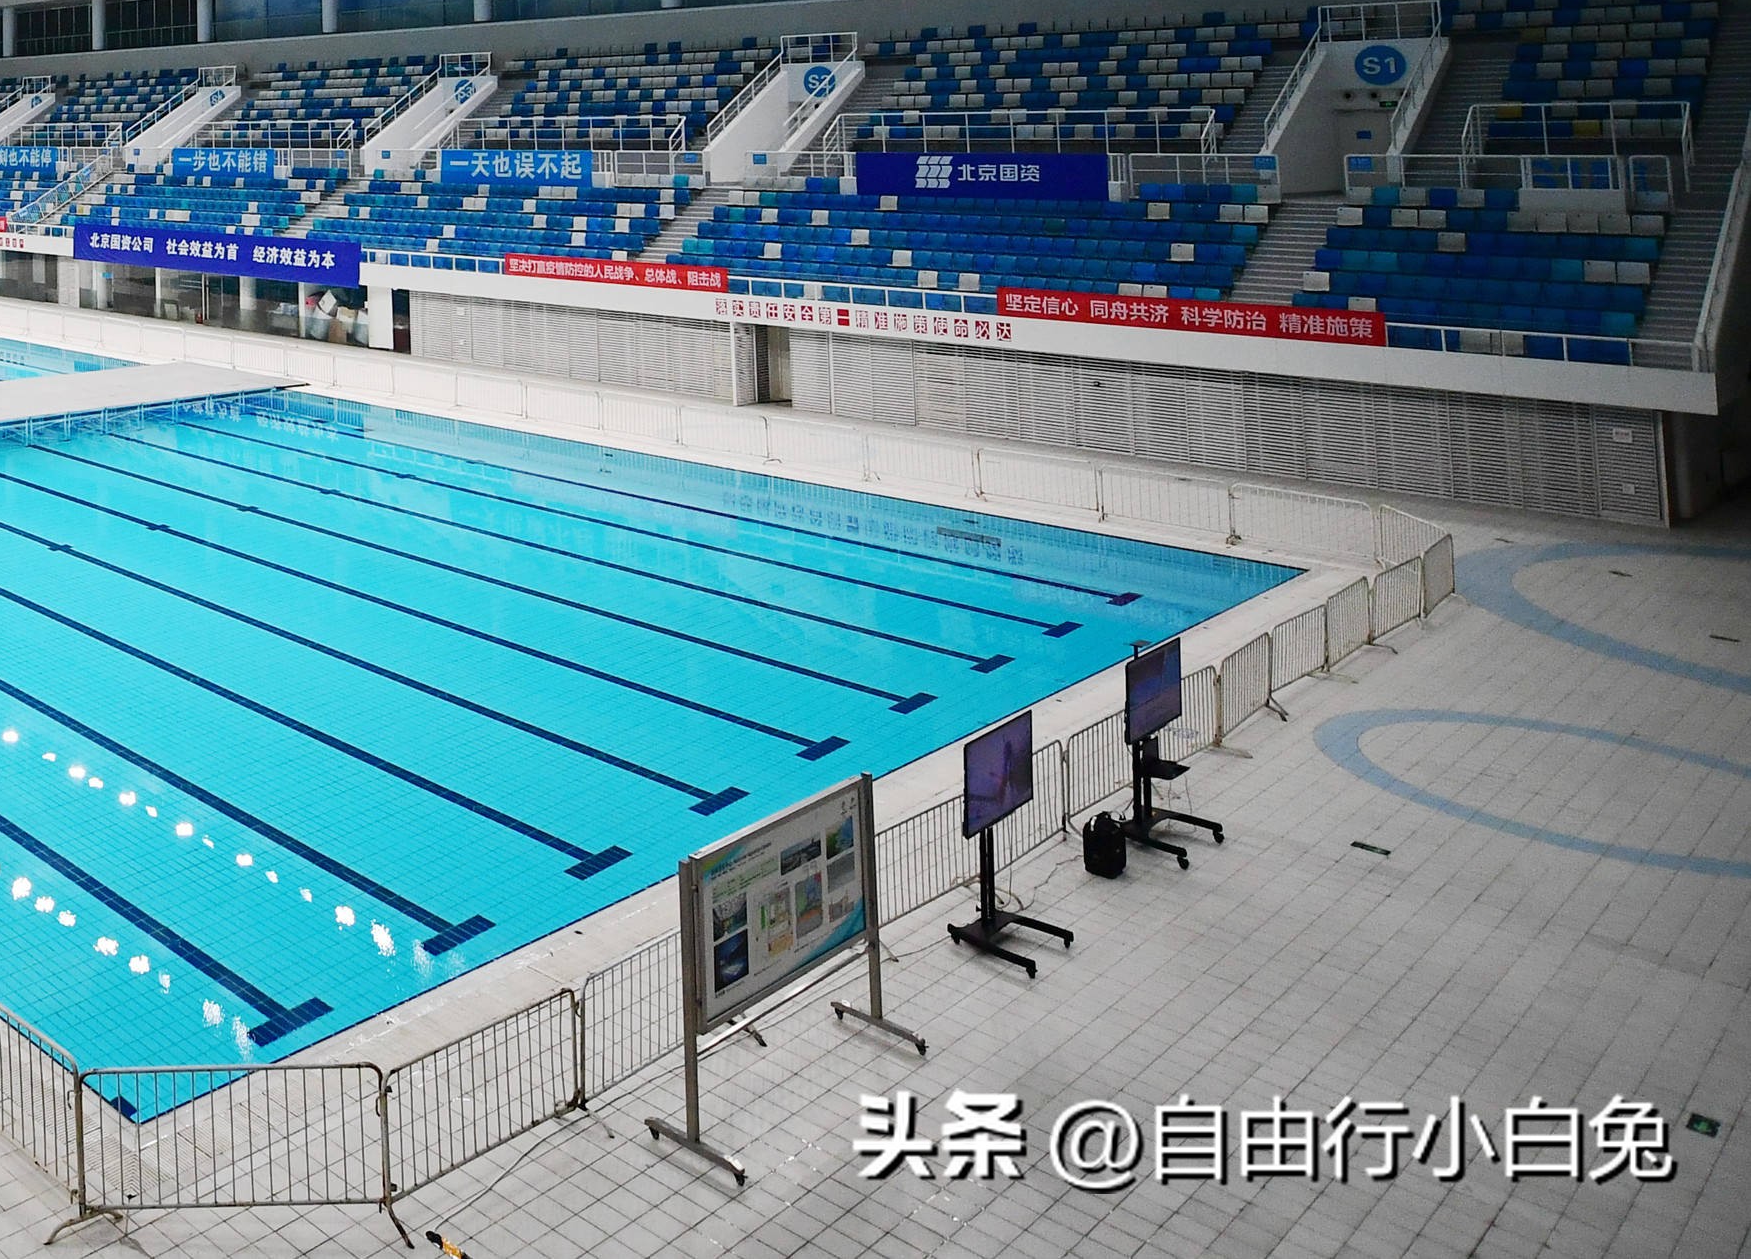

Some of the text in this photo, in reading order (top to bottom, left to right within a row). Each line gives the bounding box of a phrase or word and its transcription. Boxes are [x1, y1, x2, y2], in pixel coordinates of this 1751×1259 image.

[1362, 56, 1397, 75] S1
[808, 74, 834, 89] S2
[178, 149, 268, 174] 一步也不能错
[450, 151, 583, 180] 一天也误不起
[957, 164, 1040, 182] 北京国资
[89, 232, 336, 270] 北京国资公司 社会效益为首 经济效益为本
[1005, 293, 1373, 339] 坚定信心 同舟共济 科学防治 精准施策
